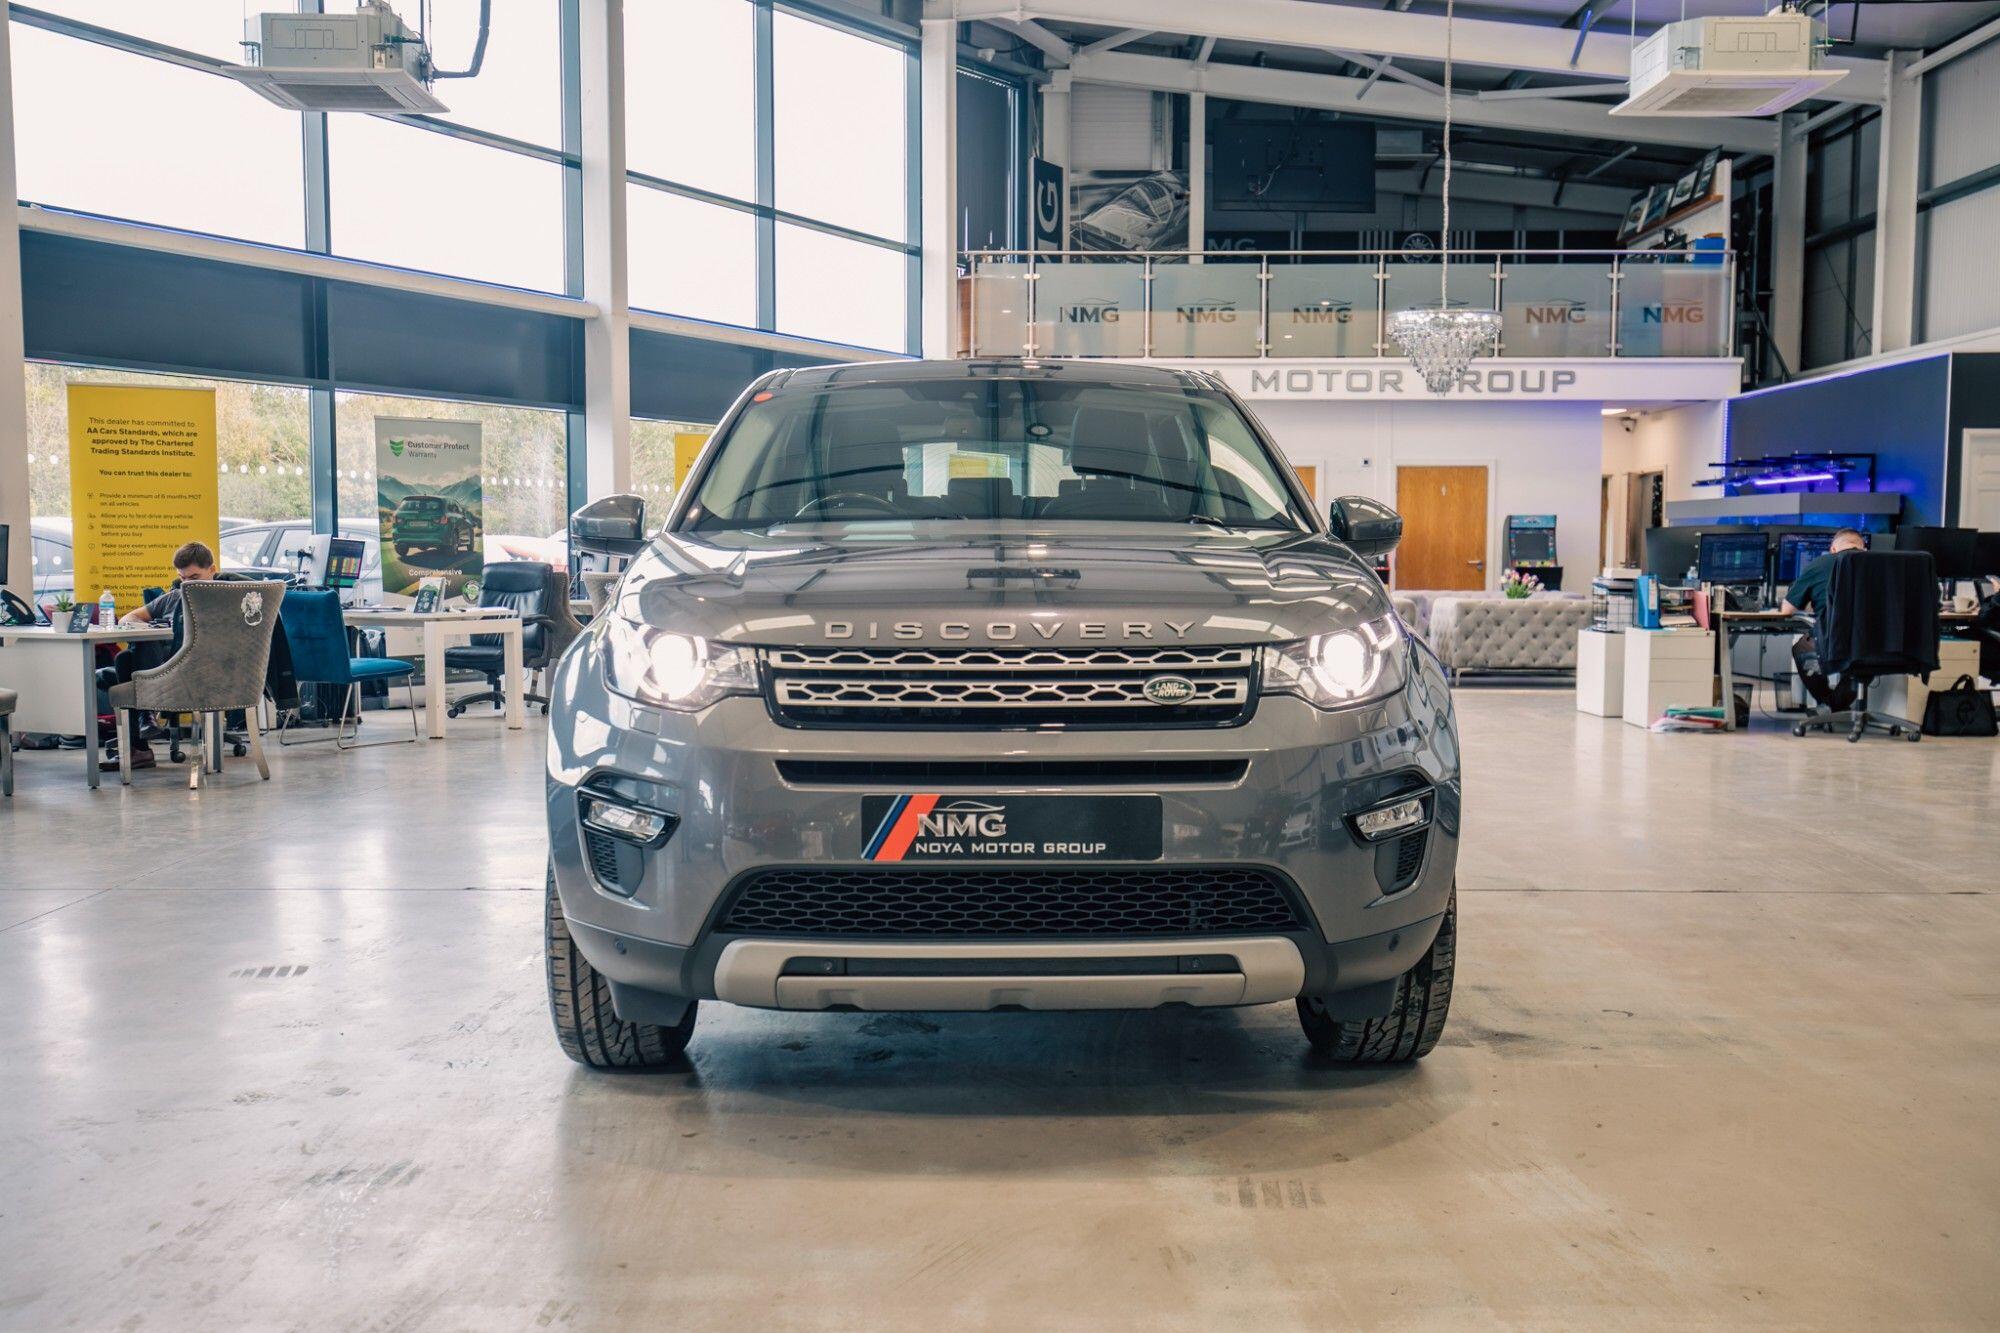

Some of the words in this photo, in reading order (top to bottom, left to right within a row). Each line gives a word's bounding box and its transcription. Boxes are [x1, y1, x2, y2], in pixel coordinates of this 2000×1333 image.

[1207, 238, 1257, 257] MG
[1059, 306, 1119, 323] NMG
[1176, 306, 1236, 323] NMG
[1293, 307, 1352, 324] NMG
[1525, 307, 1586, 324] NMG
[1643, 306, 1704, 323] NMG
[1251, 369, 1404, 393] MOTOR
[89, 417, 105, 425] This
[119, 428, 160, 437] Standards,
[92, 438, 128, 446] approved
[130, 439, 139, 447] by
[408, 441, 441, 449] Customer
[444, 442, 470, 450] Protect
[91, 448, 120, 456] Trading
[121, 448, 160, 456] Standards
[162, 449, 196, 457] Institute.
[408, 568, 463, 577] Comprehensive
[824, 621, 1196, 640] DISCOVERY
[1156, 682, 1179, 690] LAND
[1158, 689, 1187, 697] ROVER
[917, 812, 1007, 838] NMG
[915, 842, 964, 854] NOYA
[971, 842, 1035, 854] MOTOR
[1043, 842, 1107, 854] GROUP
